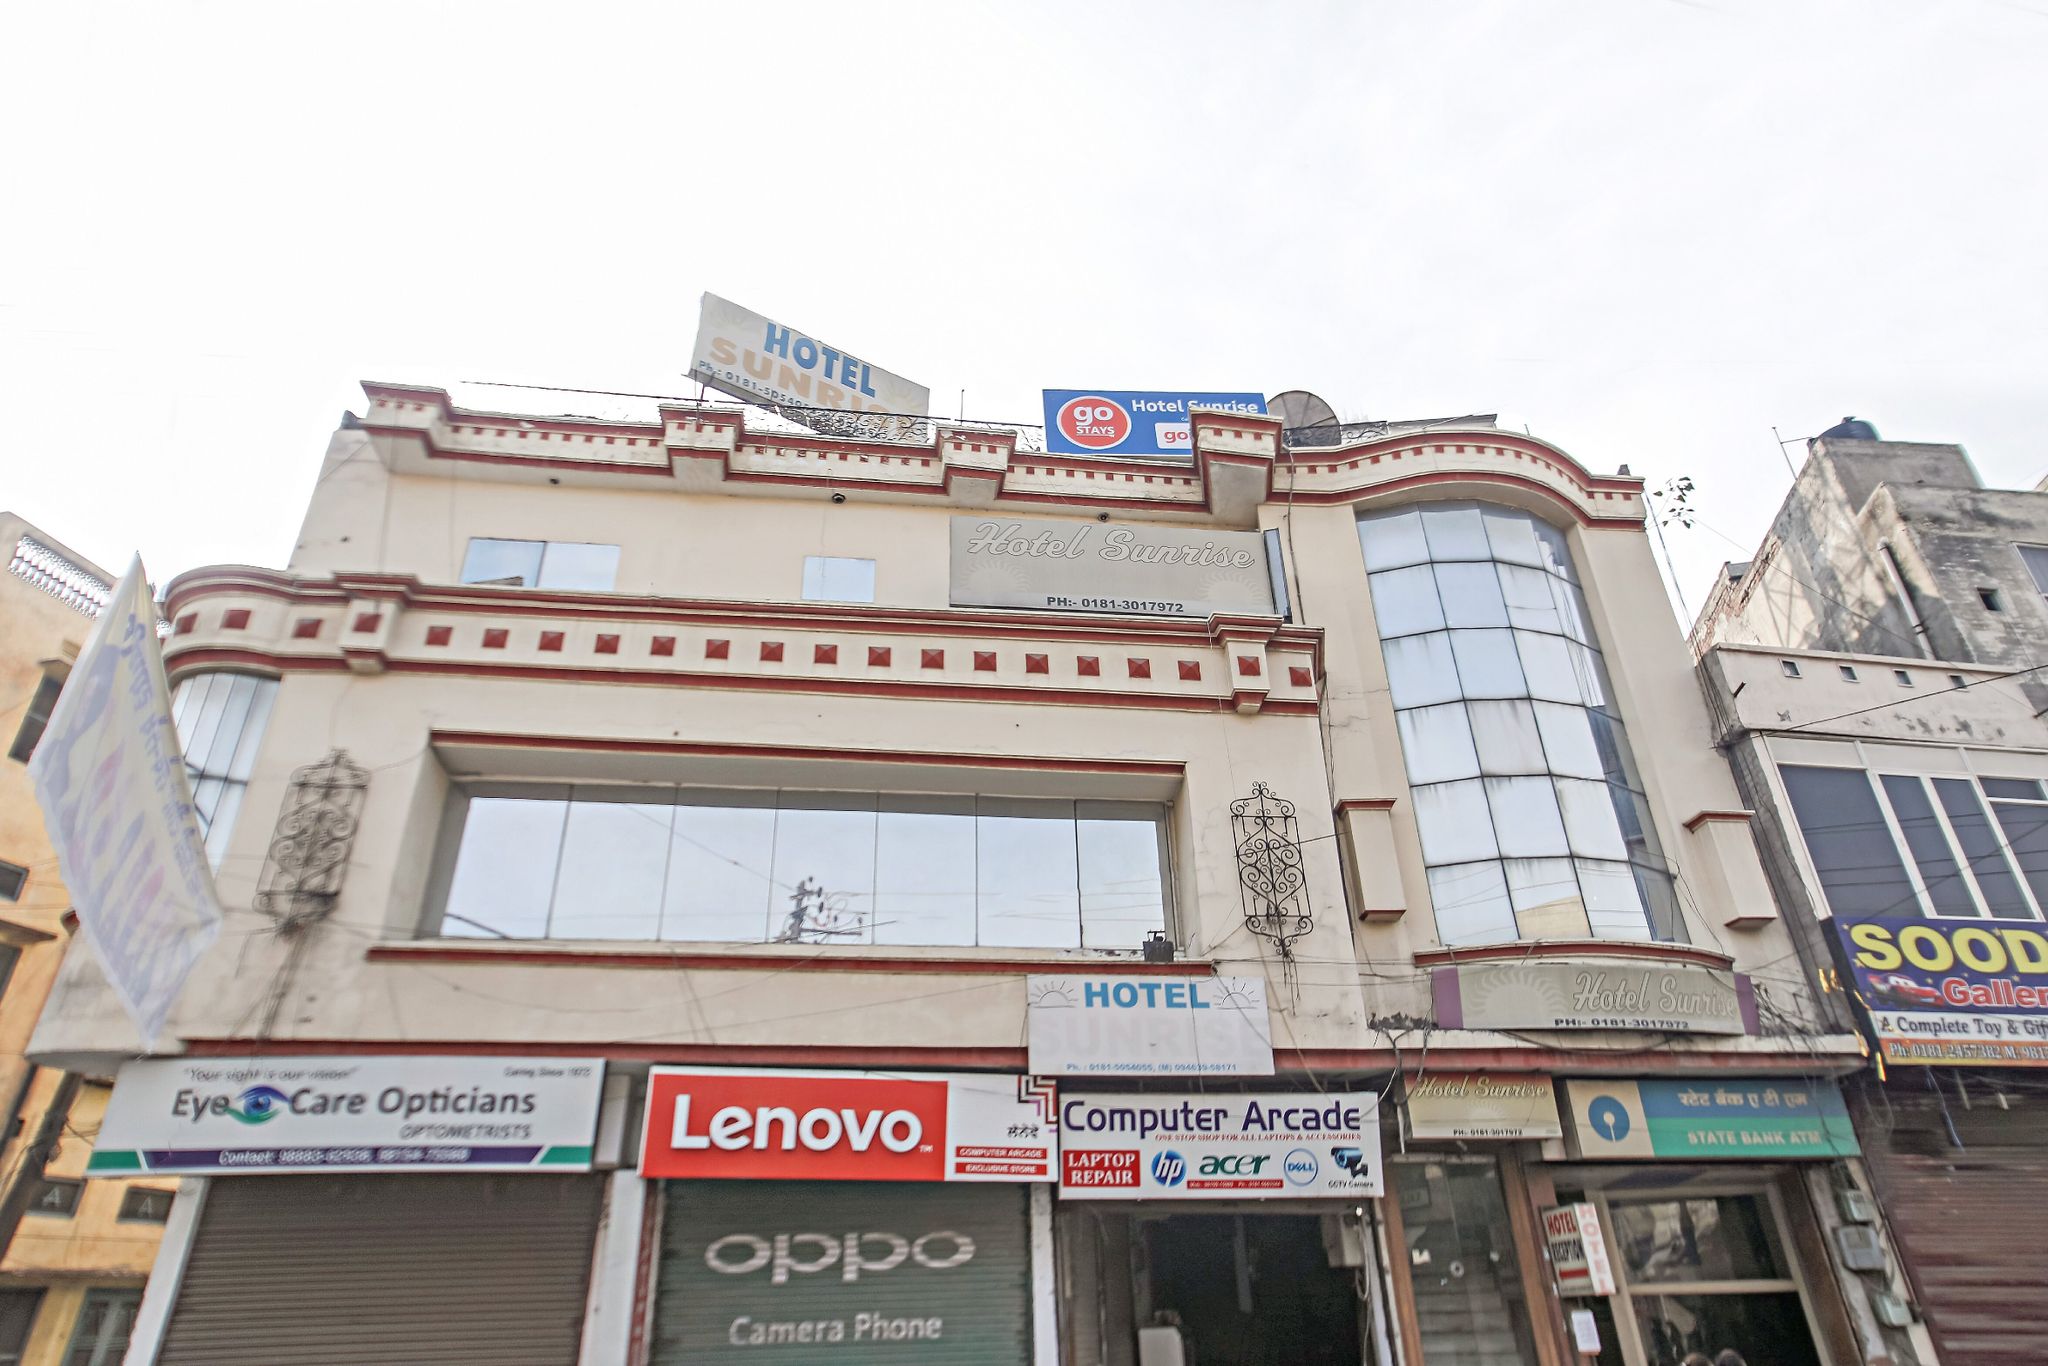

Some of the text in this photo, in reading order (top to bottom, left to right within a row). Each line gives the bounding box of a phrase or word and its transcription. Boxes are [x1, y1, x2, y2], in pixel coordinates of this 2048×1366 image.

[764, 321, 876, 398] HOTEL
[709, 336, 891, 413] SUNRI
[1072, 405, 1115, 427] go
[1132, 399, 1183, 413] Hotel
[1076, 425, 1116, 436] STAYS
[966, 522, 1256, 569] Hotel Sunrise
[1046, 596, 1184, 613] PH:- 0181-3017972
[1850, 924, 2048, 974] SOOD
[1083, 982, 1211, 1009] HOTEL
[1573, 972, 1737, 1018] Hotel Sunrise
[1590, 1018, 1690, 1029] 0181-3017972
[1897, 1016, 1970, 1036] Complete
[1973, 1018, 2001, 1039] Toy
[2007, 1019, 2020, 1035] &
[1416, 1075, 1547, 1099] Hotel Sunrise
[171, 1085, 537, 1123] Eye Care Opticians
[399, 1123, 533, 1140] OPTOMETRISTS
[670, 1093, 923, 1153] Lenovo
[1064, 1101, 1361, 1139] Computer Arcade
[1688, 1131, 1823, 1145] STATE BANK ATM
[1008, 1148, 1044, 1158] ARCADE
[1067, 1152, 1136, 1168] LAPTOP
[1199, 1154, 1271, 1176] acer
[1070, 1169, 1134, 1185] REPAIR
[1154, 1150, 1182, 1186] hp
[1286, 1162, 1316, 1173] DELL
[1328, 1179, 1349, 1189] CCTV
[1547, 1211, 1577, 1235] HOTEL
[704, 1229, 977, 1286] oppo
[1579, 1204, 1609, 1296] HOTEL
[729, 1311, 943, 1346] Camera Phone
